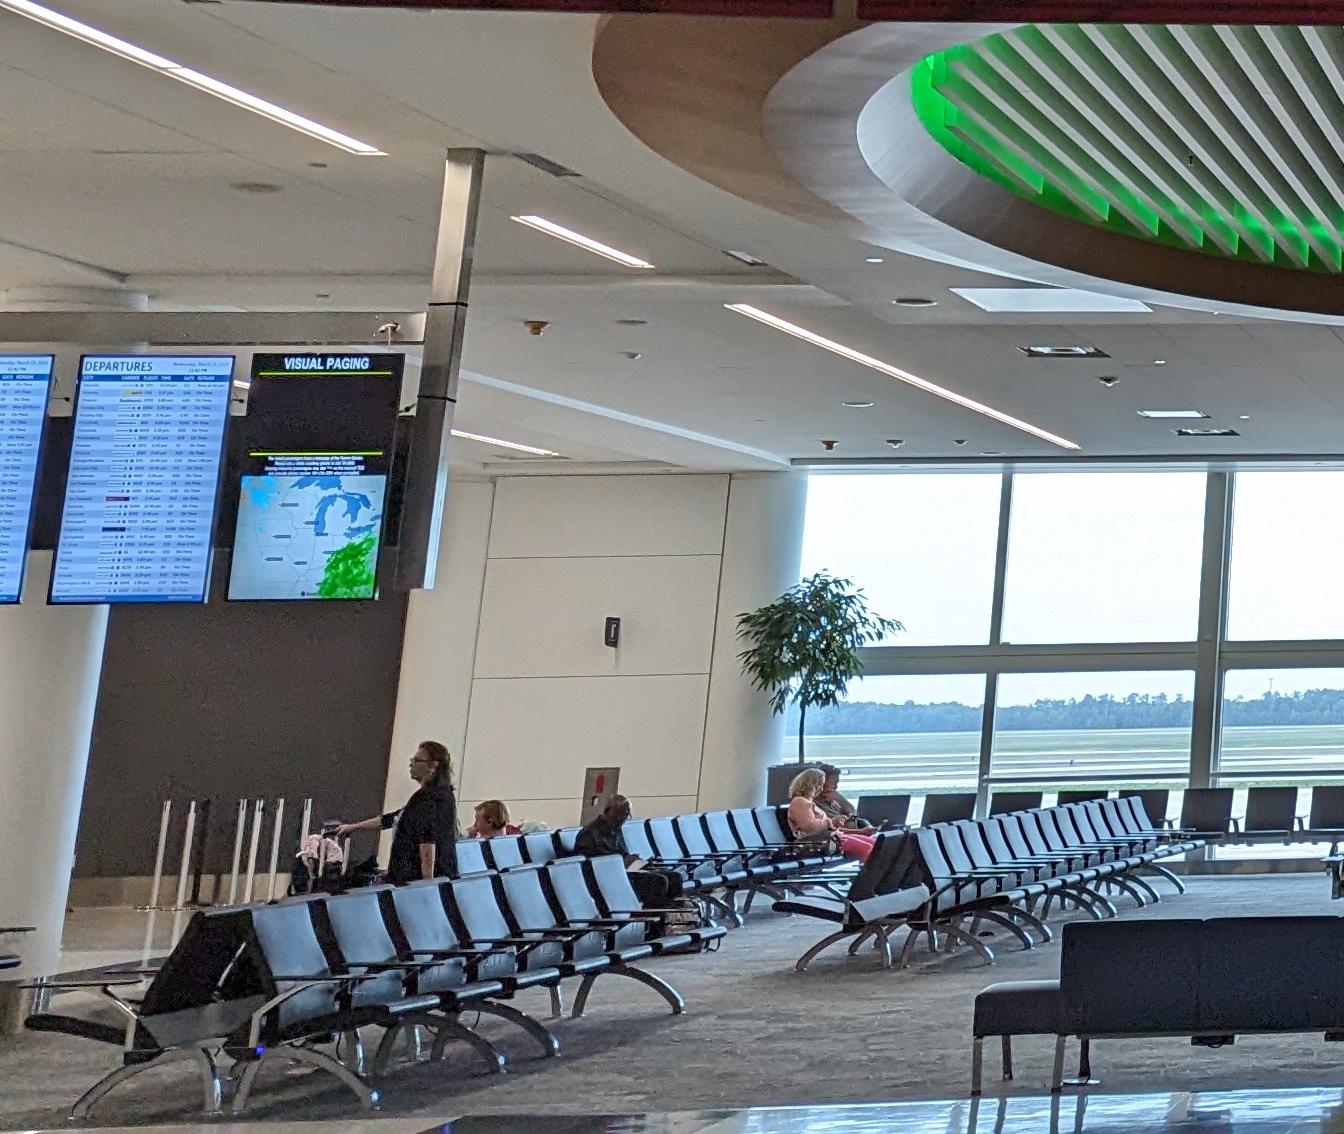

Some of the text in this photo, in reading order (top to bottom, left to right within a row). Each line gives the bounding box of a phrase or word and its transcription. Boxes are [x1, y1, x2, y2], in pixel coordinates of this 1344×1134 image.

[84, 361, 153, 372] DEPARTURES
[284, 357, 370, 370] VISUAL PAGING
